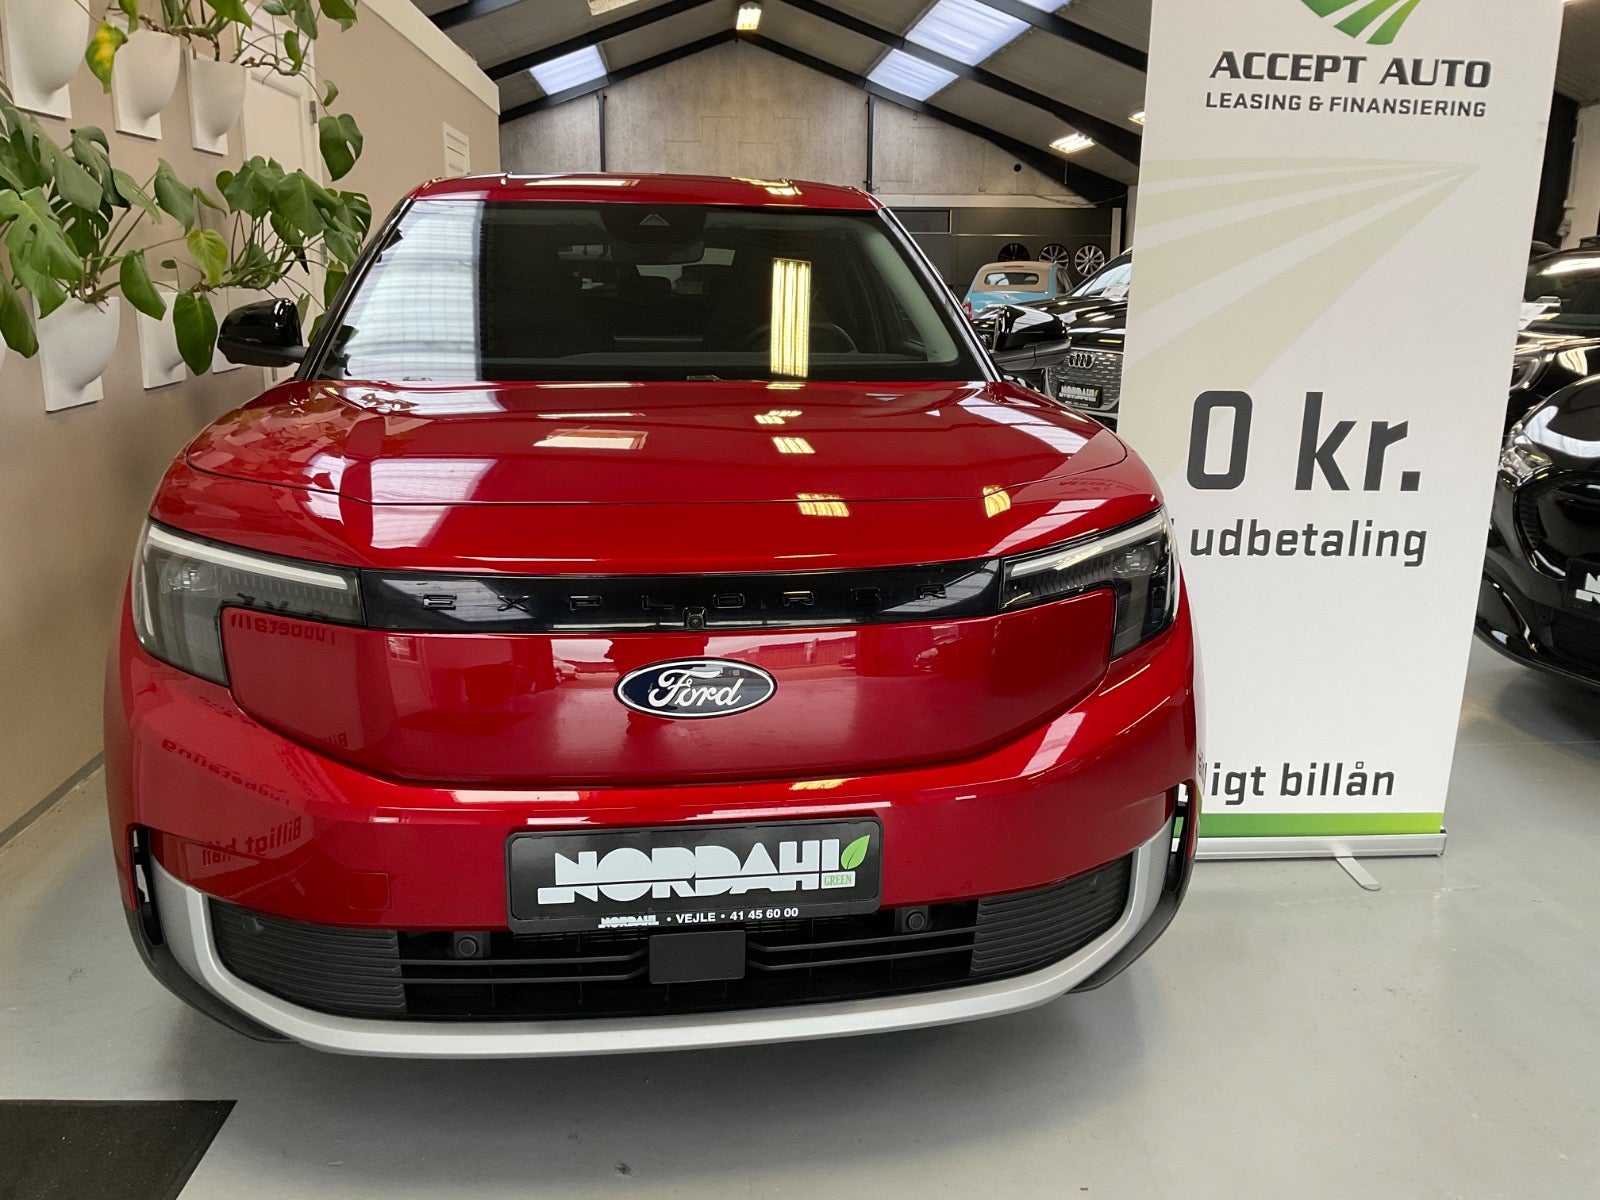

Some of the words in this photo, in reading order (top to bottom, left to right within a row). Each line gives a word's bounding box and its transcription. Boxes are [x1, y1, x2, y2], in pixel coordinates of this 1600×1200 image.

[1209, 51, 1368, 84] ACCEPT
[1379, 57, 1491, 88] AUTO
[1205, 91, 1302, 111] LEASING
[1308, 95, 1324, 112] &
[1329, 96, 1486, 118] FINANSIERING
[1186, 390, 1253, 490] 0
[1294, 391, 1421, 492] kr.
[1190, 518, 1427, 567] udbetaling
[422, 582, 947, 613] EXPLORER
[647, 668, 745, 708] Ford
[1280, 761, 1395, 797] billån
[823, 872, 853, 887] GREEN
[675, 912, 716, 924] VEJLE
[729, 910, 744, 921] 41
[747, 909, 763, 920] 45
[765, 908, 781, 919] 60
[783, 907, 799, 918] 00
